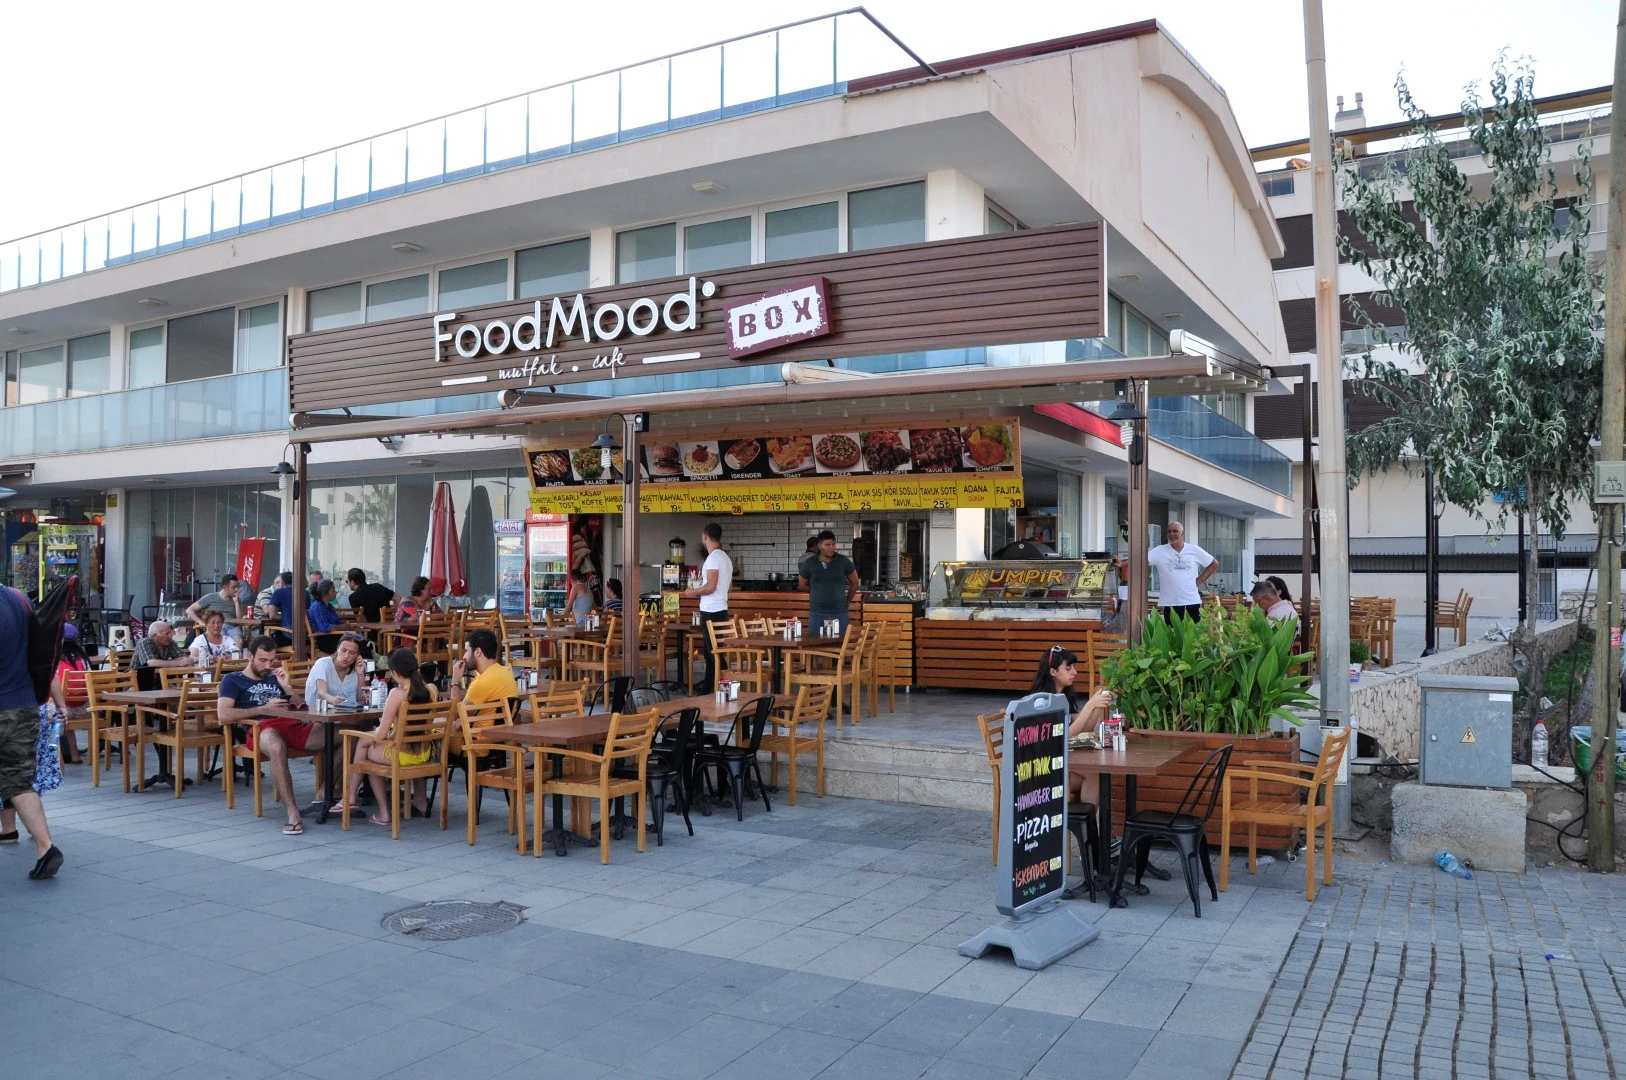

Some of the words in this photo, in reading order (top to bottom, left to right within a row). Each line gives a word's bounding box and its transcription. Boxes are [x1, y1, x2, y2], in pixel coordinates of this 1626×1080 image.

[434, 276, 697, 362] FoodMood
[738, 296, 813, 338] BOX
[498, 355, 563, 386] mutfak
[592, 346, 626, 379] cafe
[849, 489, 871, 498] TAVUK
[899, 486, 918, 496] SOSLU
[920, 487, 940, 496] TAVUK
[940, 486, 957, 495] SOTE
[963, 485, 989, 493] ADANA
[996, 486, 1021, 495] FAJITA
[751, 494, 759, 502] ET
[761, 491, 782, 502] DÖNER
[782, 493, 799, 501] TAVUK
[799, 491, 816, 501] DÖNER
[581, 497, 603, 506] KÖFTE
[804, 502, 810, 510] 9
[860, 502, 872, 510] 25
[892, 499, 912, 507] TAVUK
[1010, 499, 1022, 508] 30
[732, 505, 742, 513] 28
[771, 503, 781, 511] 15
[839, 502, 849, 511] 15
[498, 521, 520, 532] HAYAT
[1041, 722, 1052, 742] ET
